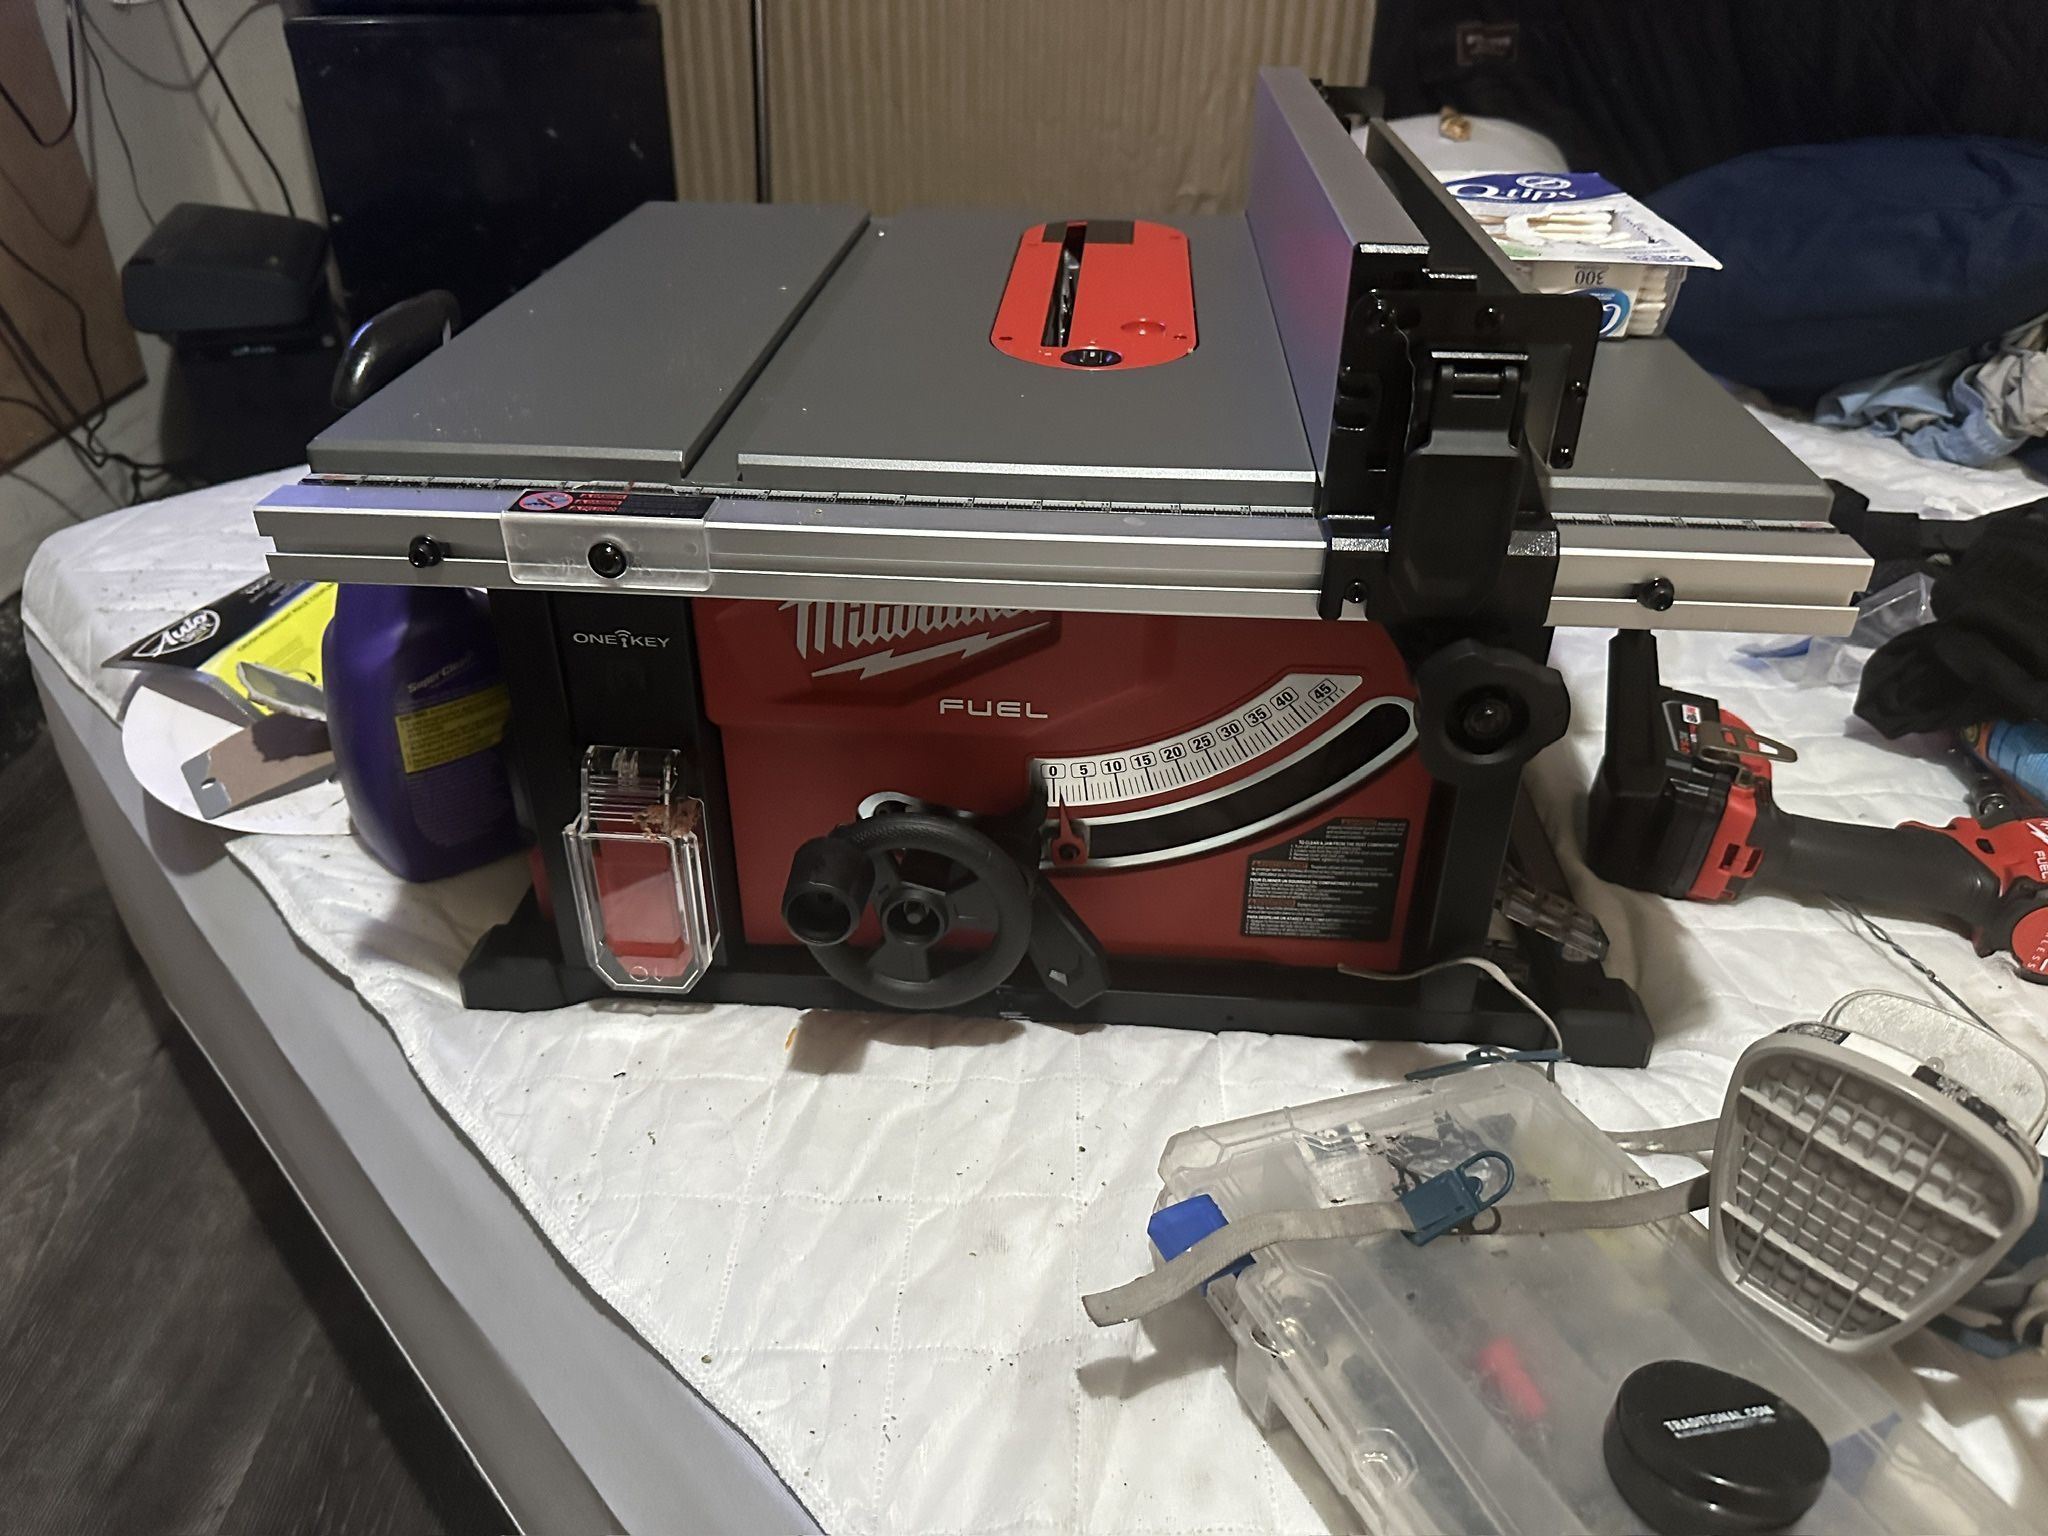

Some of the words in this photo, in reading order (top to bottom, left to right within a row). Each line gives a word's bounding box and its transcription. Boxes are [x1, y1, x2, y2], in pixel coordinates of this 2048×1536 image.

[939, 698, 1049, 719] FUEL
[1048, 765, 1058, 777] 0
[1079, 764, 1088, 776] 5
[1104, 760, 1121, 773] 10
[1134, 754, 1152, 767] 15
[1164, 746, 1182, 760] 20
[1193, 735, 1211, 750] 25
[1221, 723, 1240, 738] 30
[1248, 708, 1267, 724] 35
[1276, 691, 1294, 707] 40
[1314, 683, 1332, 700] 45
